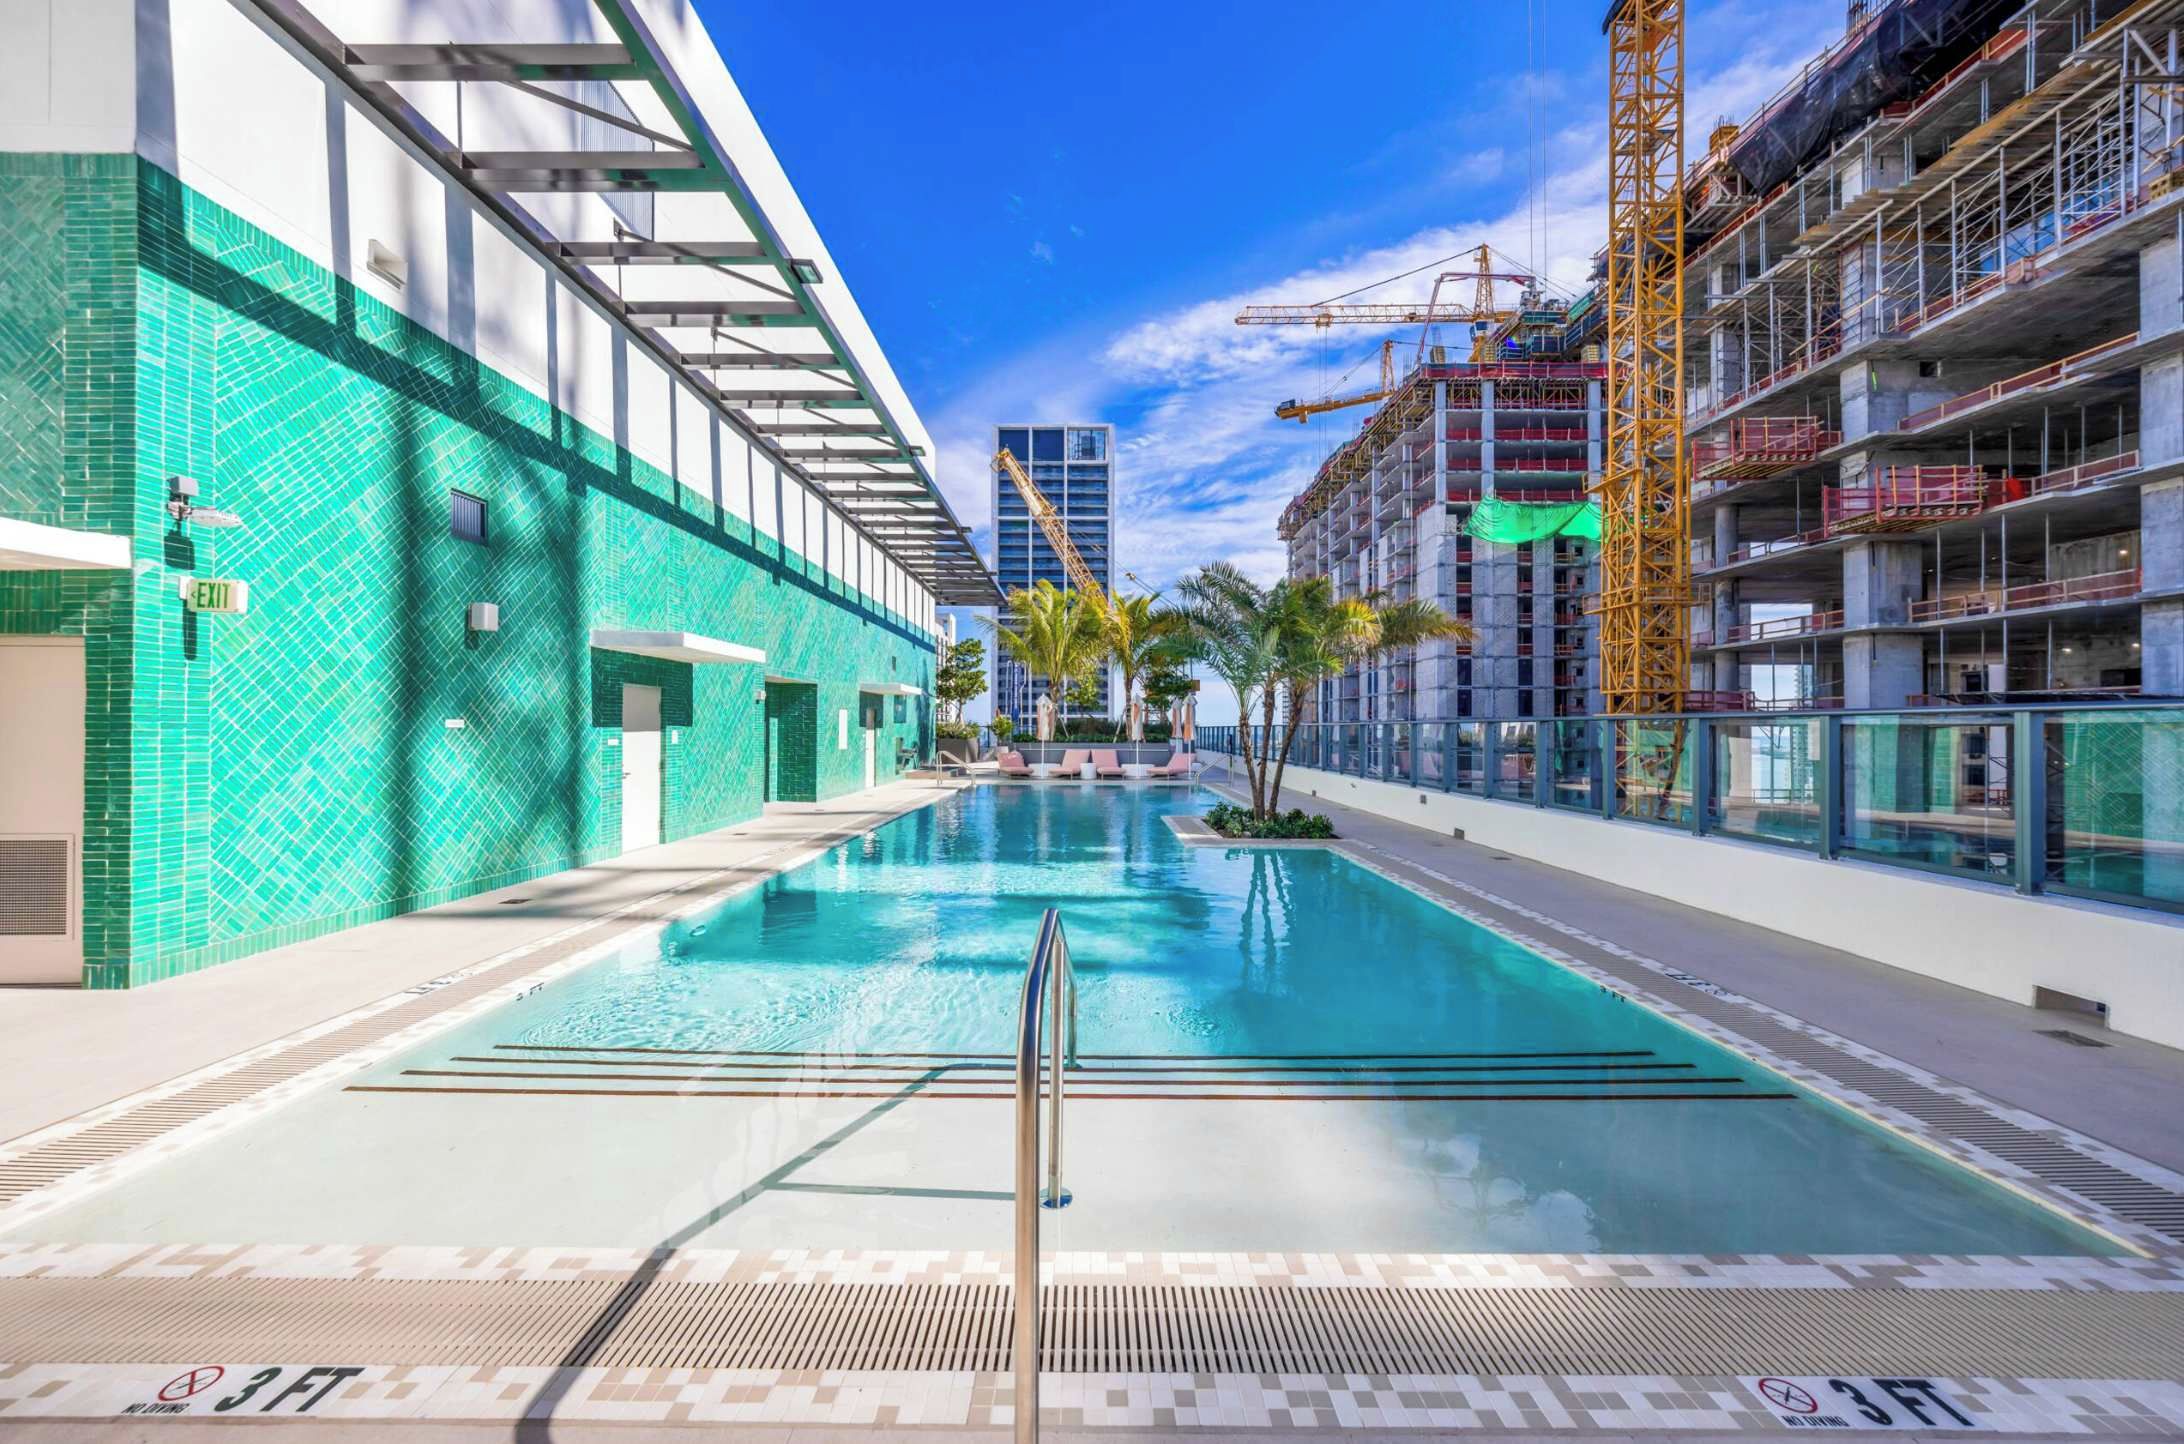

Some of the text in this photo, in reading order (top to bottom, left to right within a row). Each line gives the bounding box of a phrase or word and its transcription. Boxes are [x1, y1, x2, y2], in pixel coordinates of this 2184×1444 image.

[196, 582, 231, 609] EXIT
[213, 1366, 366, 1412] 3 FT
[1828, 1378, 1975, 1427] 3 FT
[121, 1403, 191, 1414] NO DIVING
[1781, 1415, 1851, 1427] NO DIVING
